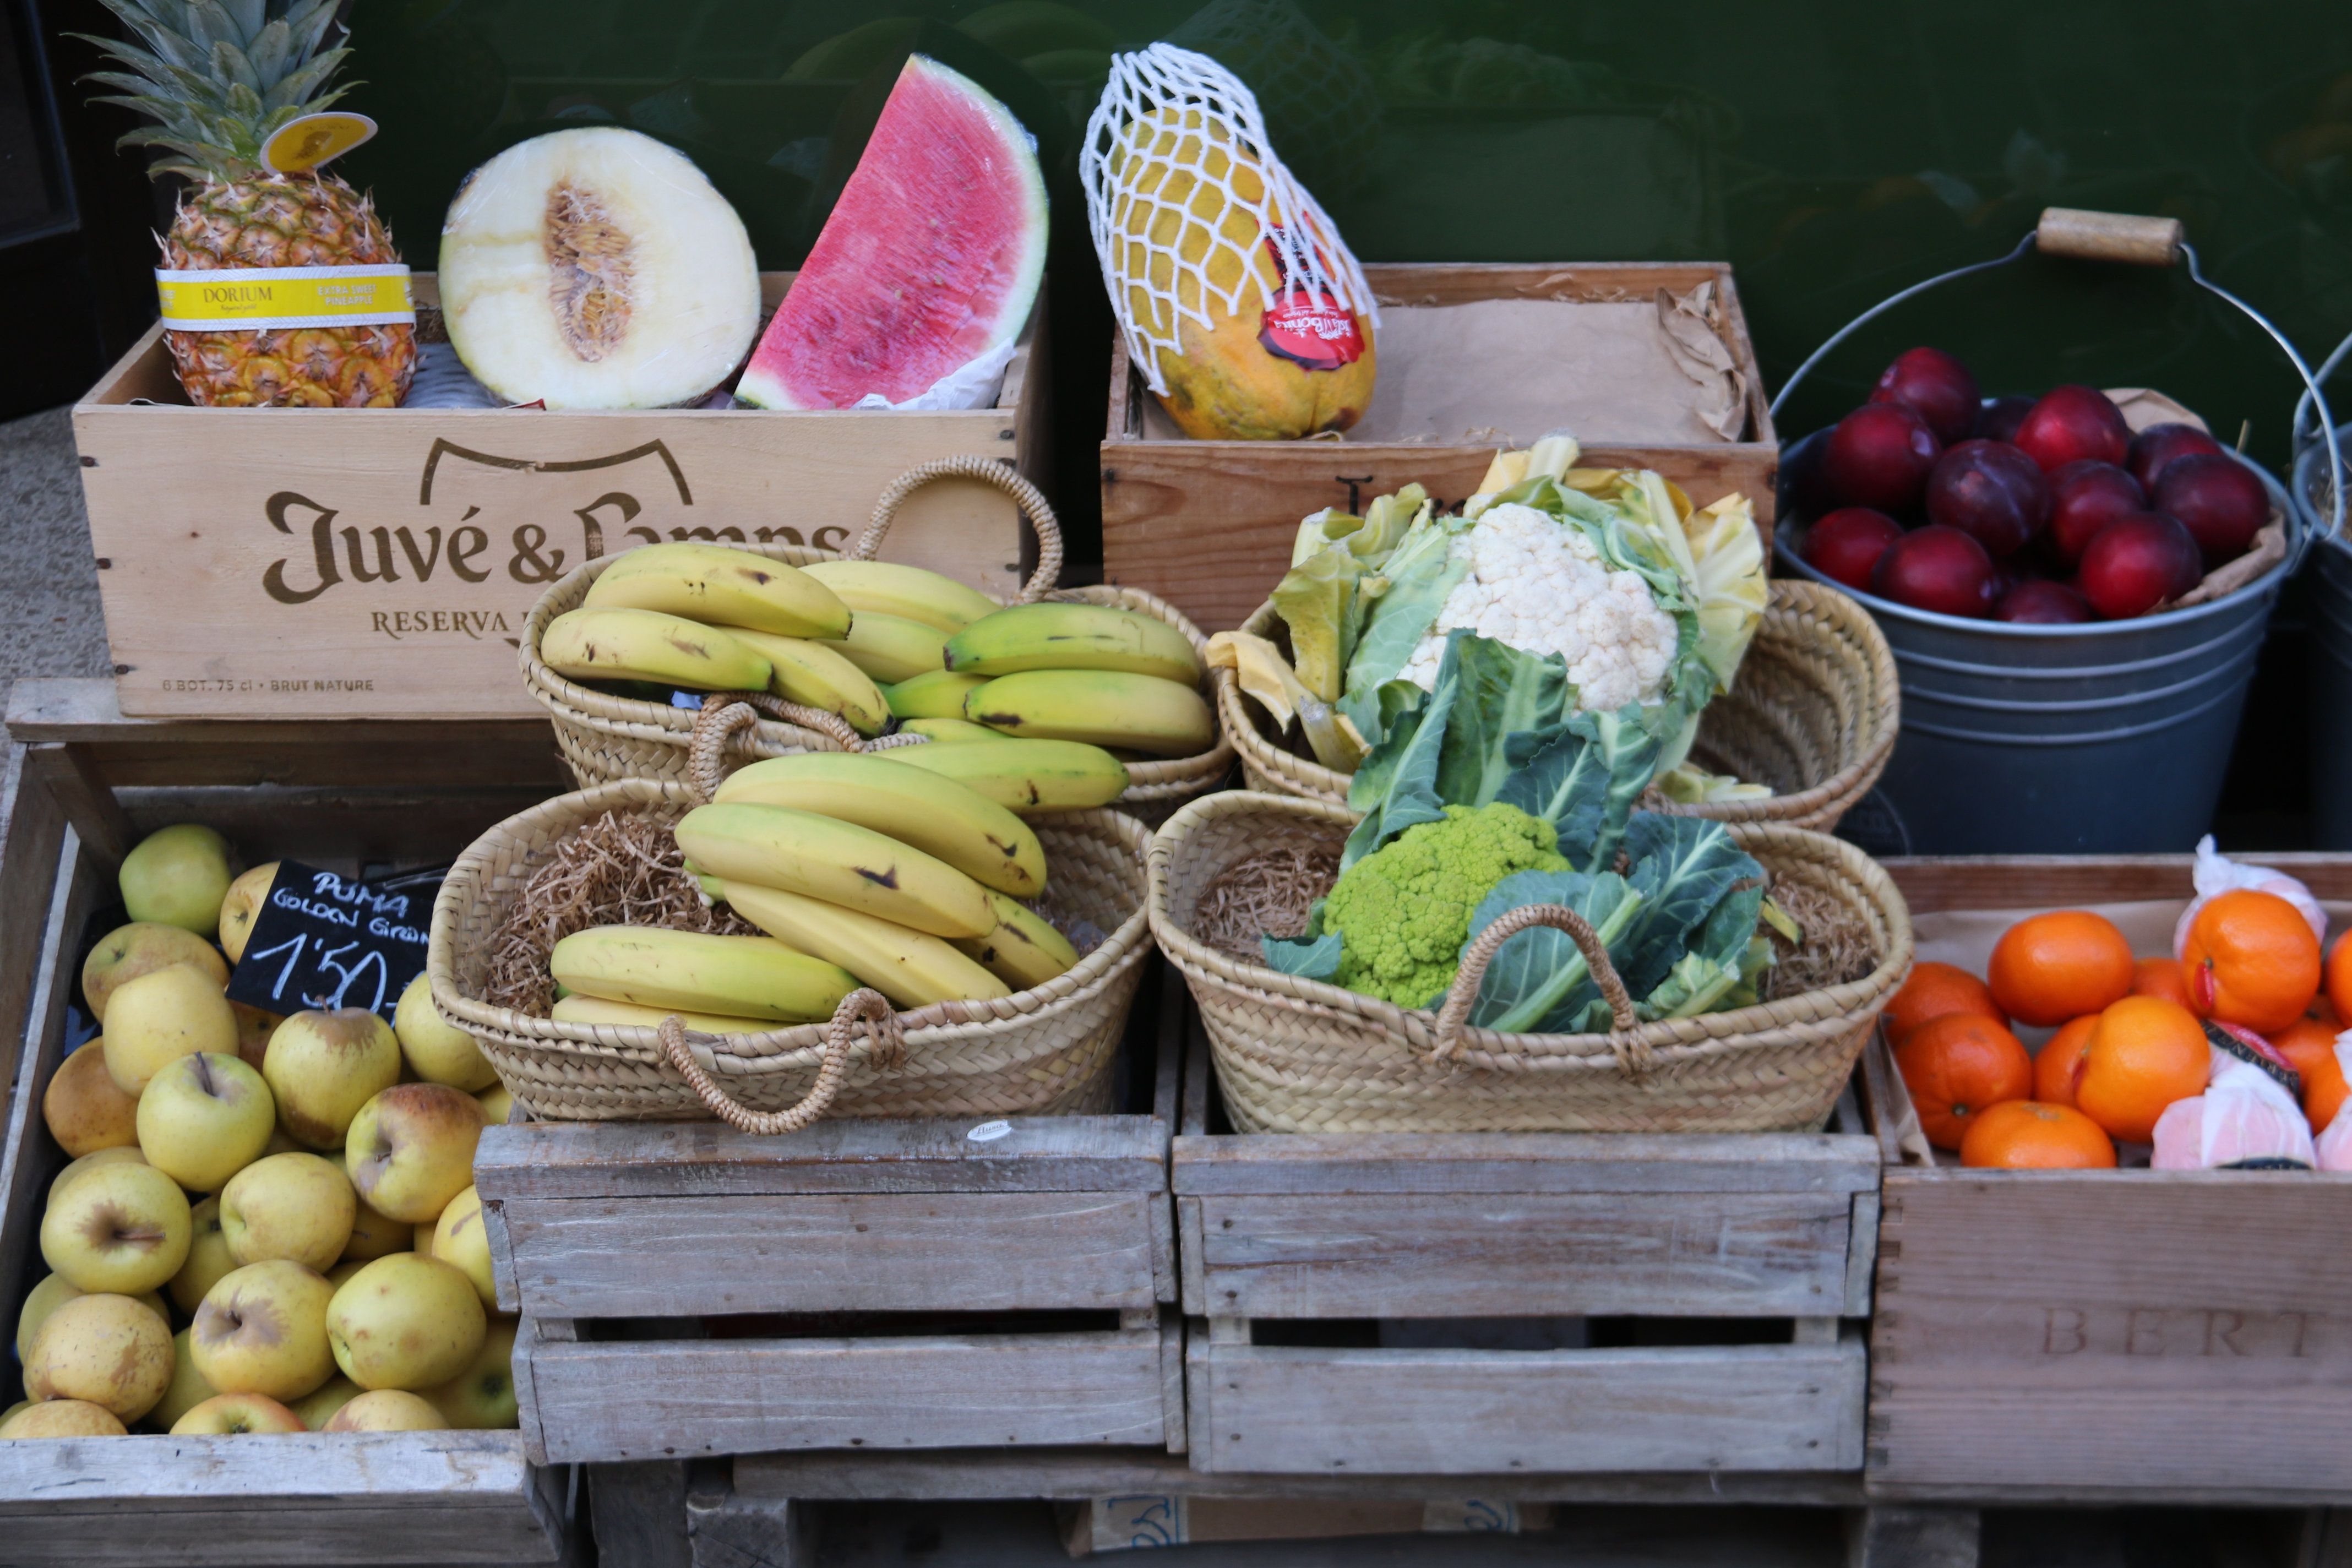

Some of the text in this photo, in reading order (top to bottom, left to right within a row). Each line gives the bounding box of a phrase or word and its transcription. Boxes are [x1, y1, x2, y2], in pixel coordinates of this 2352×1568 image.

[203, 286, 273, 303] DORIUM
[318, 284, 377, 296] EXTRA SWEET
[325, 295, 374, 307] PINEAPPLE
[263, 491, 492, 604] Juvé
[508, 524, 569, 584] &
[371, 611, 510, 640] RESERVA
[177, 679, 213, 692] BOT.
[217, 679, 234, 692] 75
[270, 679, 309, 692] BRUT
[314, 679, 374, 692] NATURE
[2041, 1307, 2328, 1358] BERT
